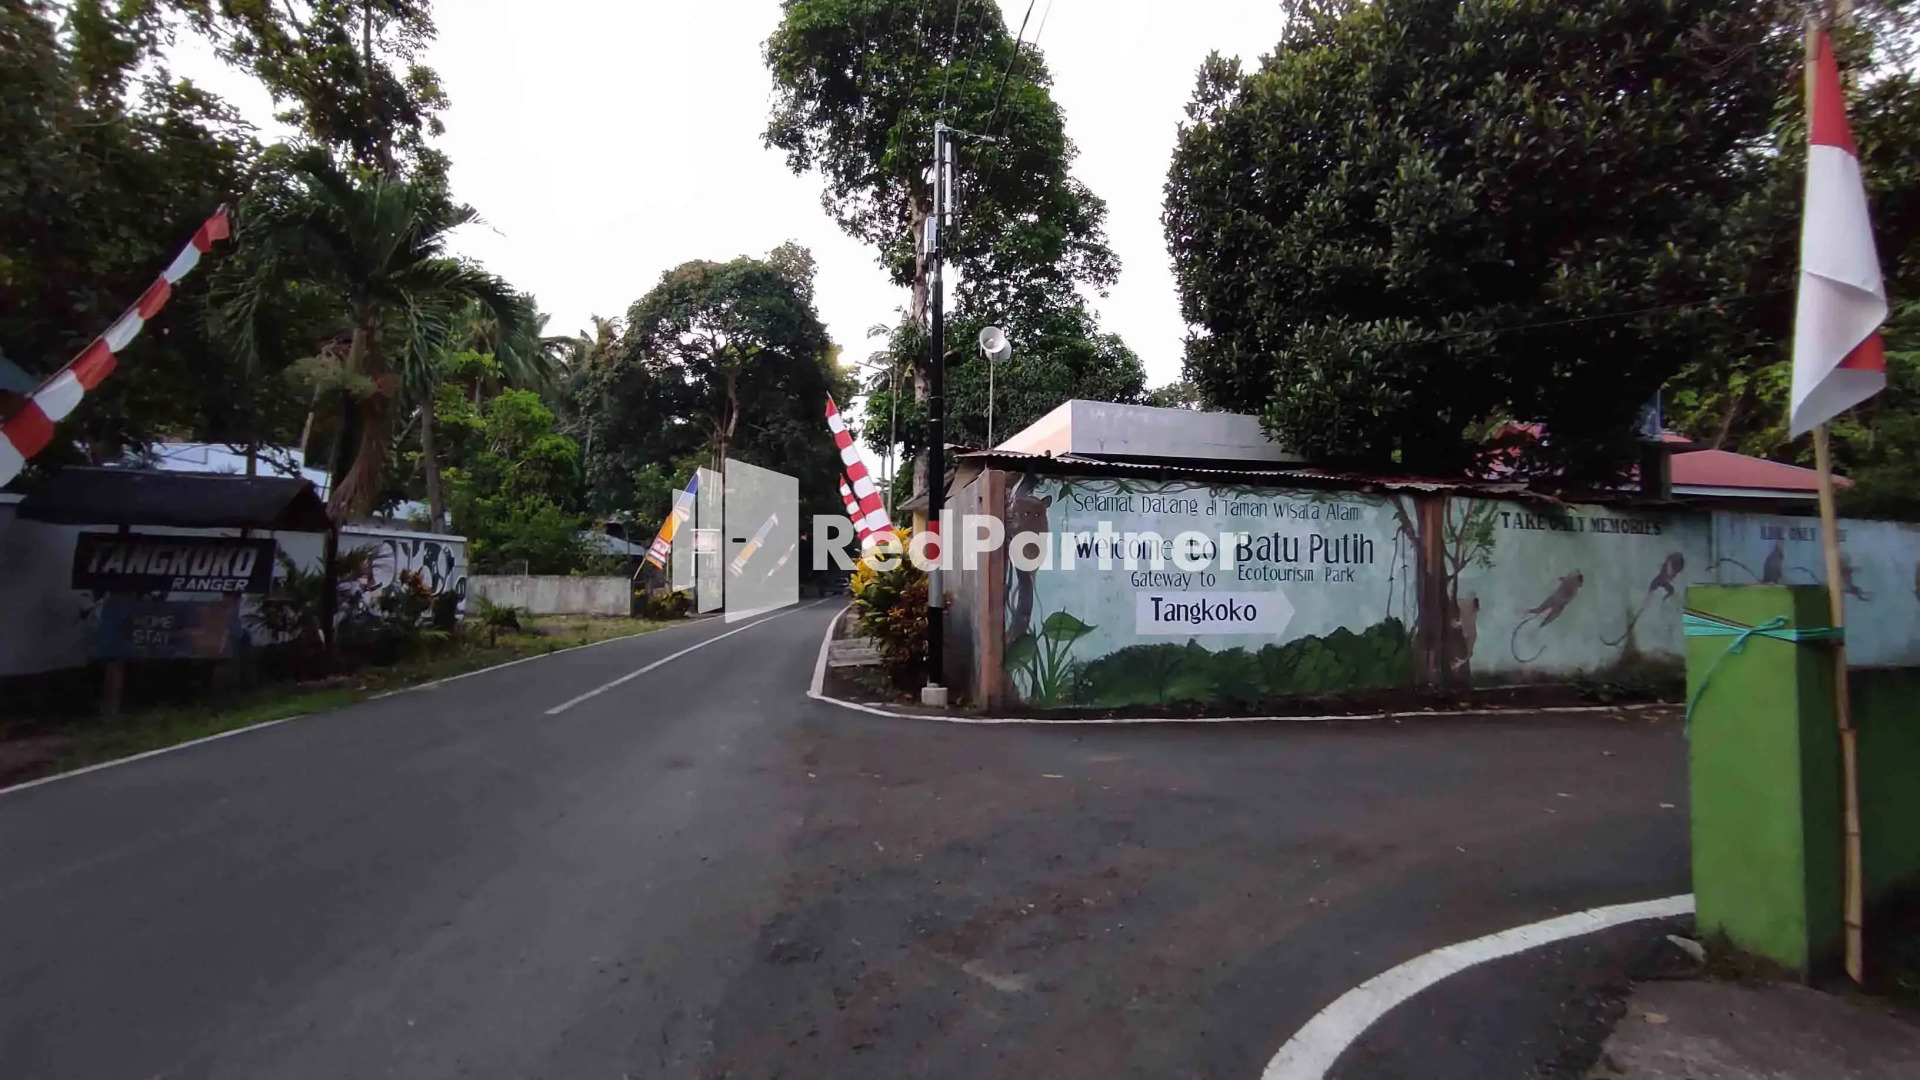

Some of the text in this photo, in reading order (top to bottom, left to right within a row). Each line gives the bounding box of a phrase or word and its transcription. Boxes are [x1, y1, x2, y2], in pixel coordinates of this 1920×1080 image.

[1074, 493, 1134, 512] Selamat
[1141, 496, 1198, 516] Datang
[1224, 500, 1267, 517] Taman
[1326, 503, 1359, 521] Alam
[1501, 512, 1546, 531] TAKE
[1590, 518, 1663, 536] MEMORIES
[88, 543, 258, 577] TANGKOKO
[1236, 532, 1299, 562] Batu
[1310, 533, 1374, 564] Putih
[171, 577, 249, 592] RANGER
[1130, 564, 1356, 592] Gateway to Ecotourism Park
[1151, 596, 1258, 625] Tangkoko
